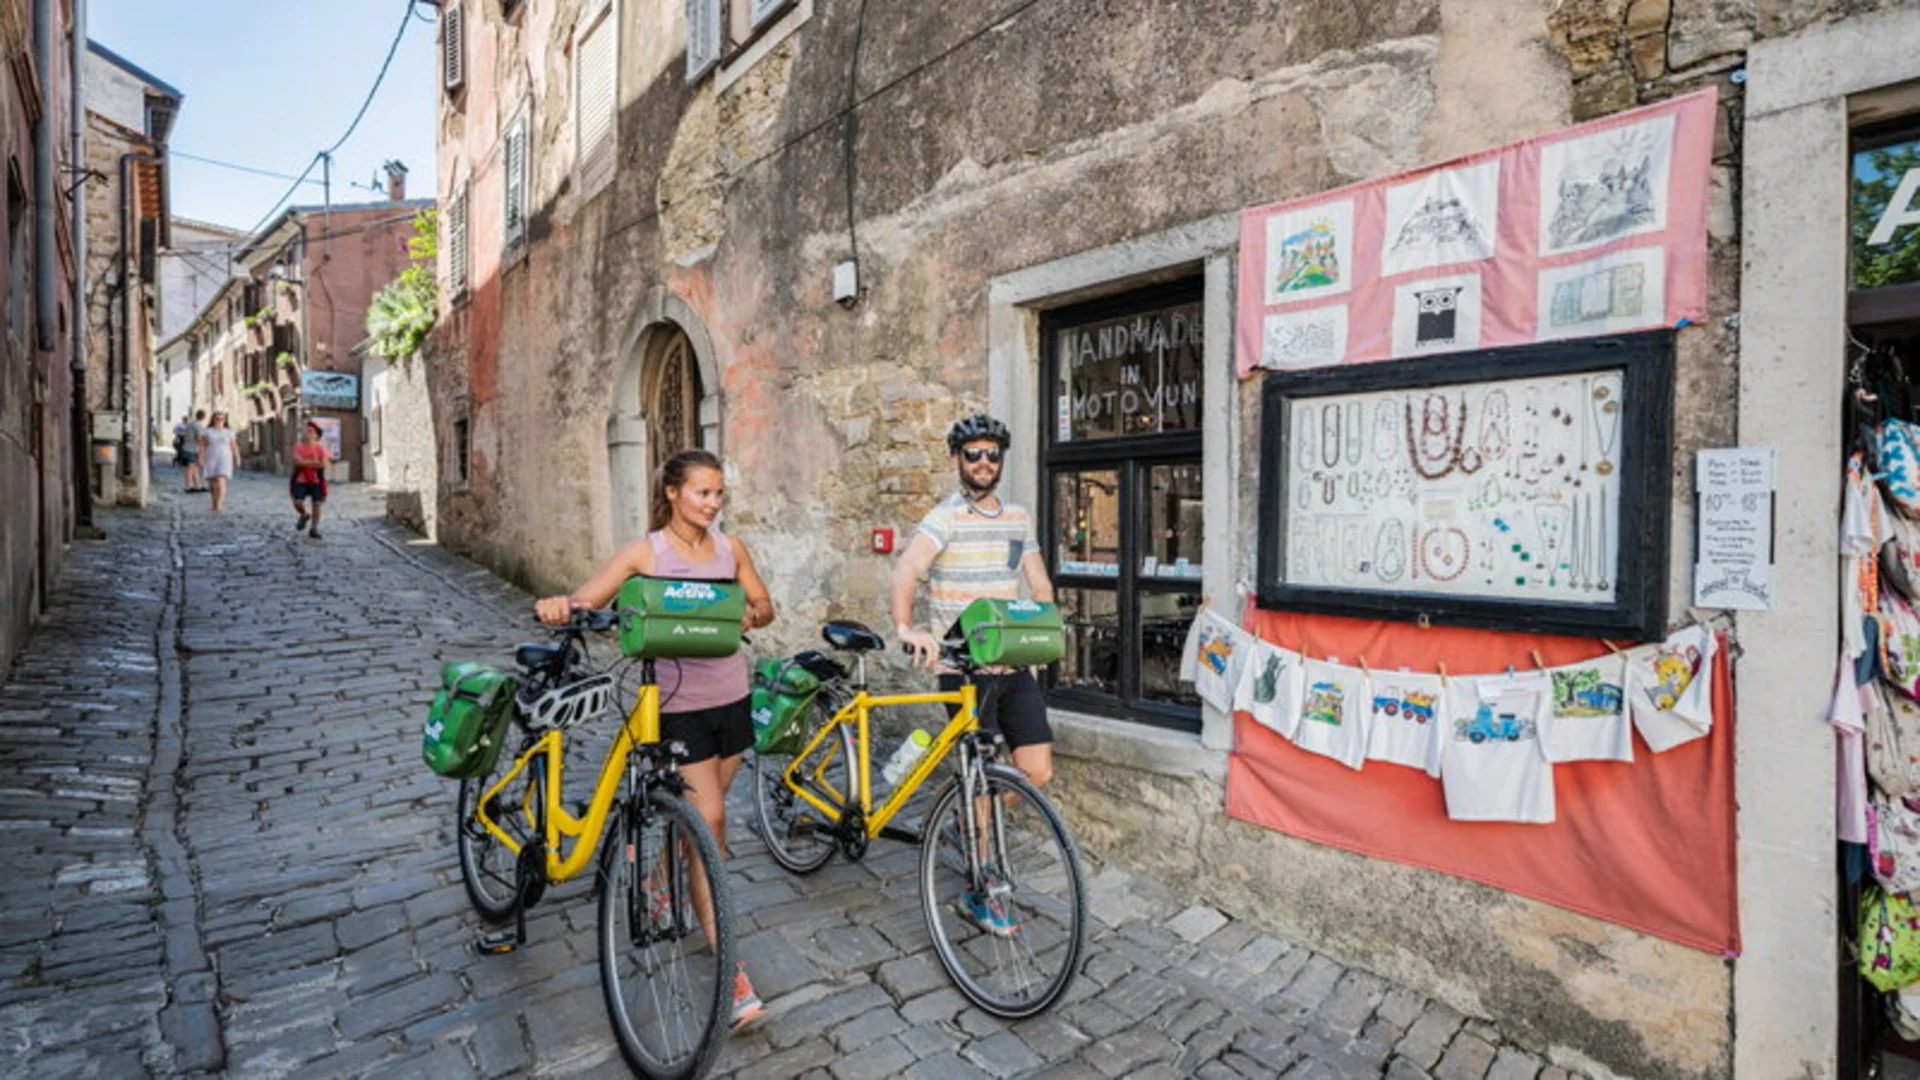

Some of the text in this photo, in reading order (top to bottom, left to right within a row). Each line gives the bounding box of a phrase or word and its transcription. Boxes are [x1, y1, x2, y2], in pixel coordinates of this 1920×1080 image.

[1068, 314, 1204, 368] HANDMADE
[1120, 365, 1140, 384] IN
[1072, 381, 1196, 420] MOTOVUN
